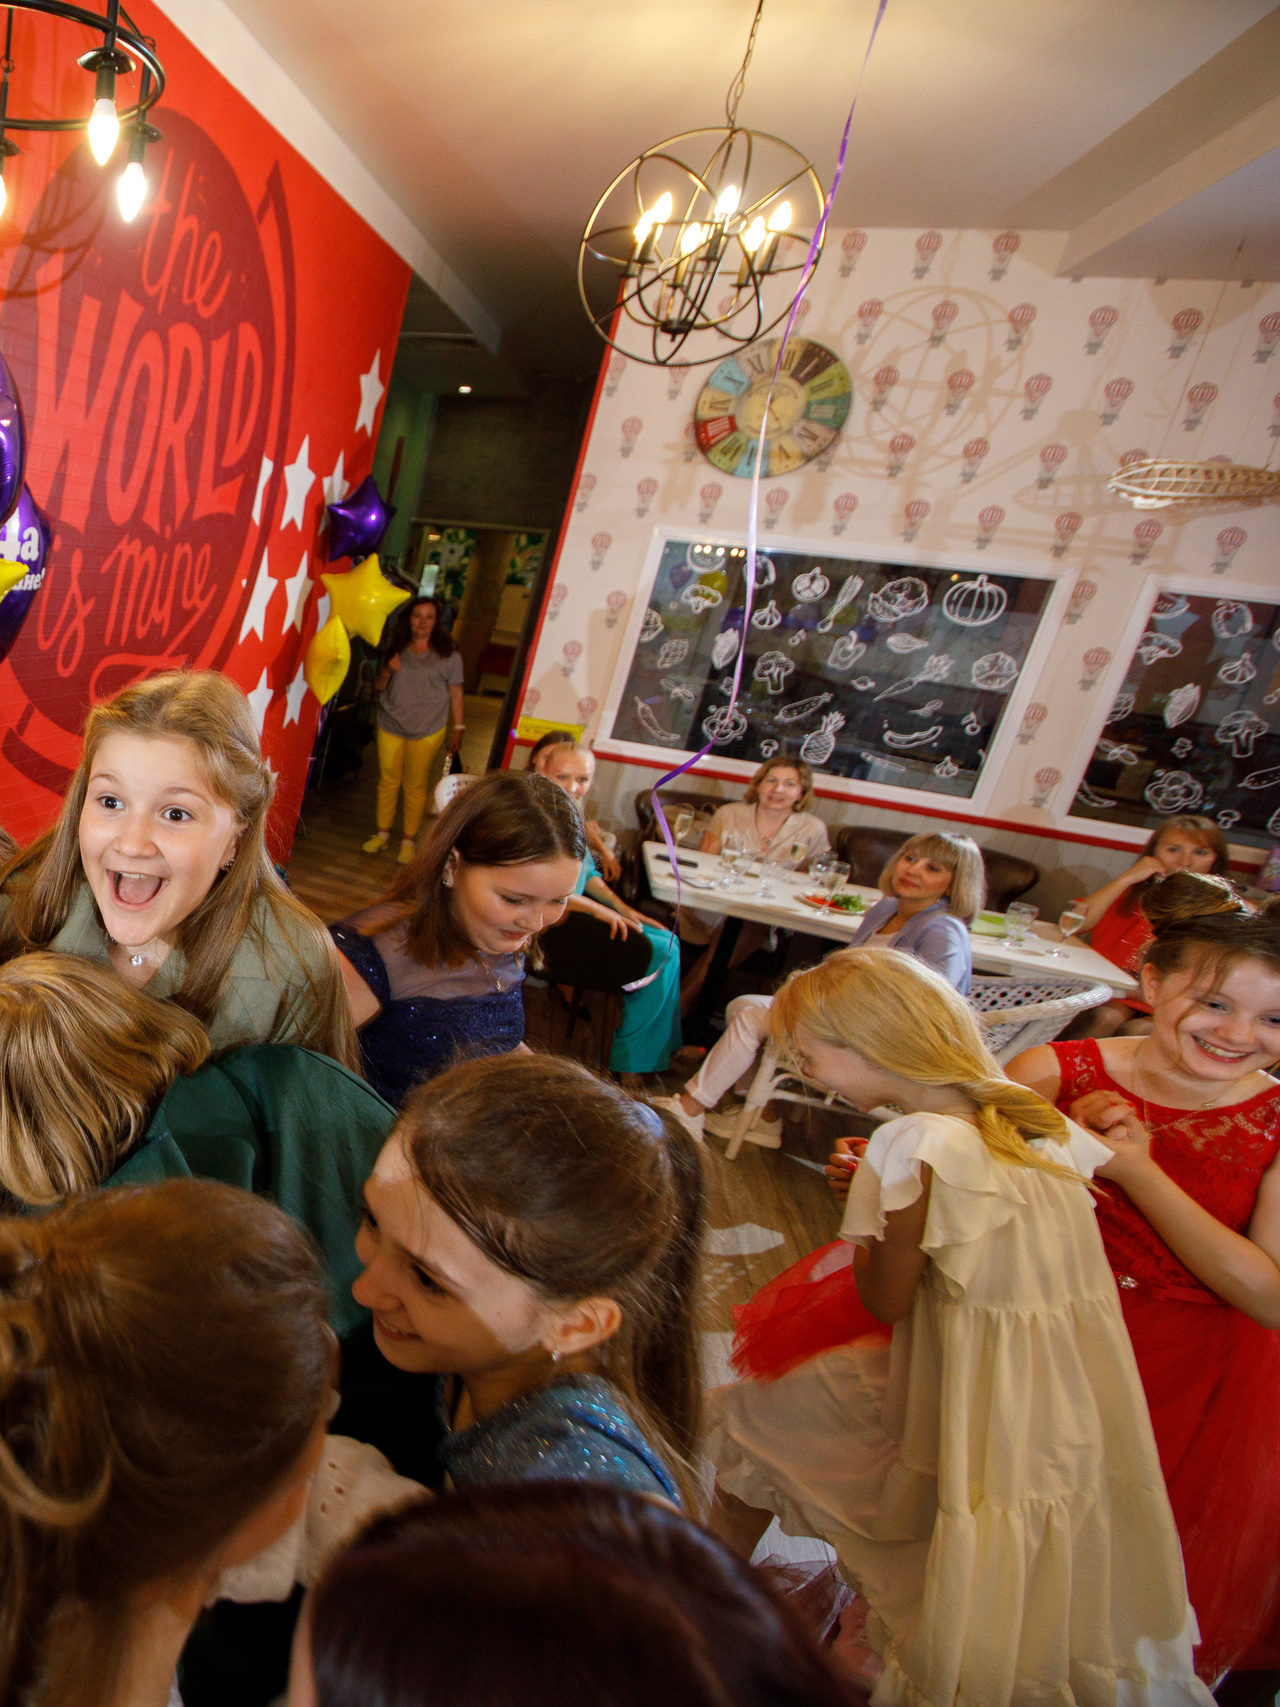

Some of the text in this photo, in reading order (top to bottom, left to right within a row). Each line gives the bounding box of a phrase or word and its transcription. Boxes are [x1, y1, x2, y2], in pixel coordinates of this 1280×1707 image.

[138, 148, 232, 319] the
[24, 244, 264, 534] WORLD
[37, 523, 218, 678] is mine
